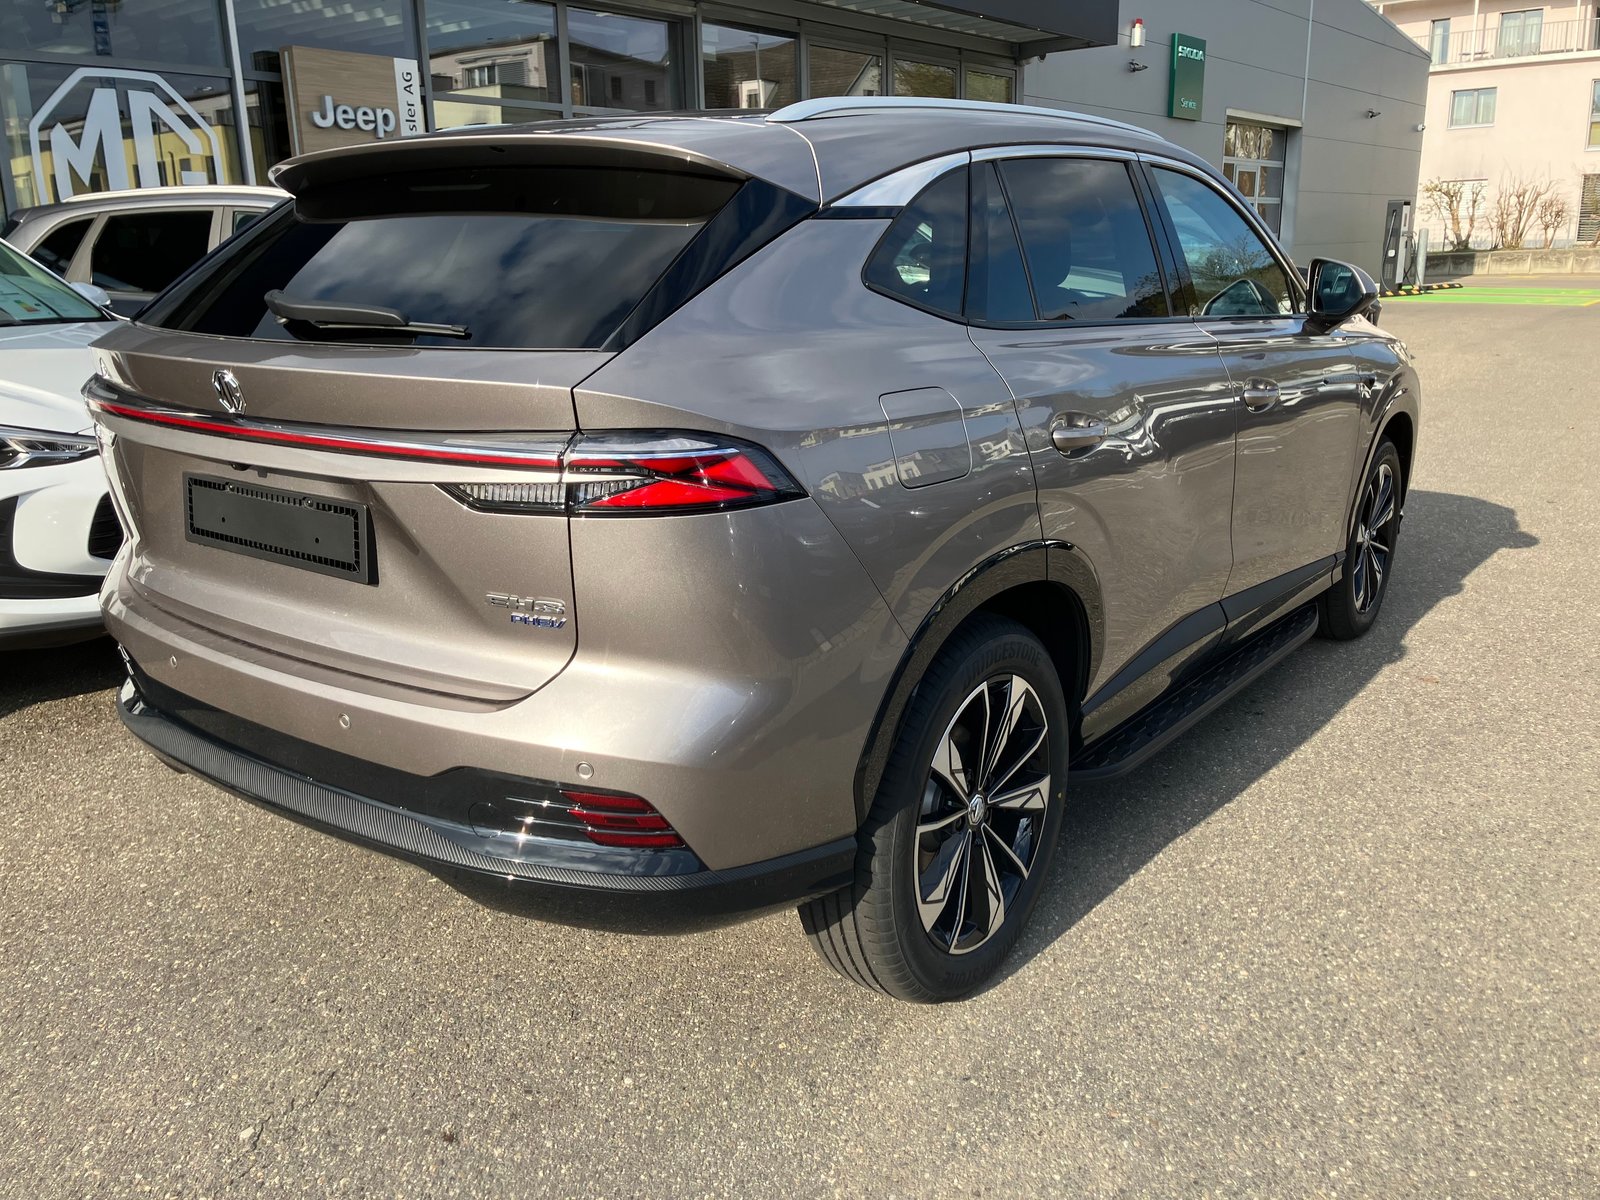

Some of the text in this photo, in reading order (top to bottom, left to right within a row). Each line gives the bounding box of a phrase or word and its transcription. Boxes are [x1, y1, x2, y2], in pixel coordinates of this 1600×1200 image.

[311, 95, 396, 139] Jeep
[401, 71, 418, 135] sler AG
[50, 87, 208, 203] MG
[486, 591, 566, 615] EHS
[510, 611, 567, 629] PHEV
